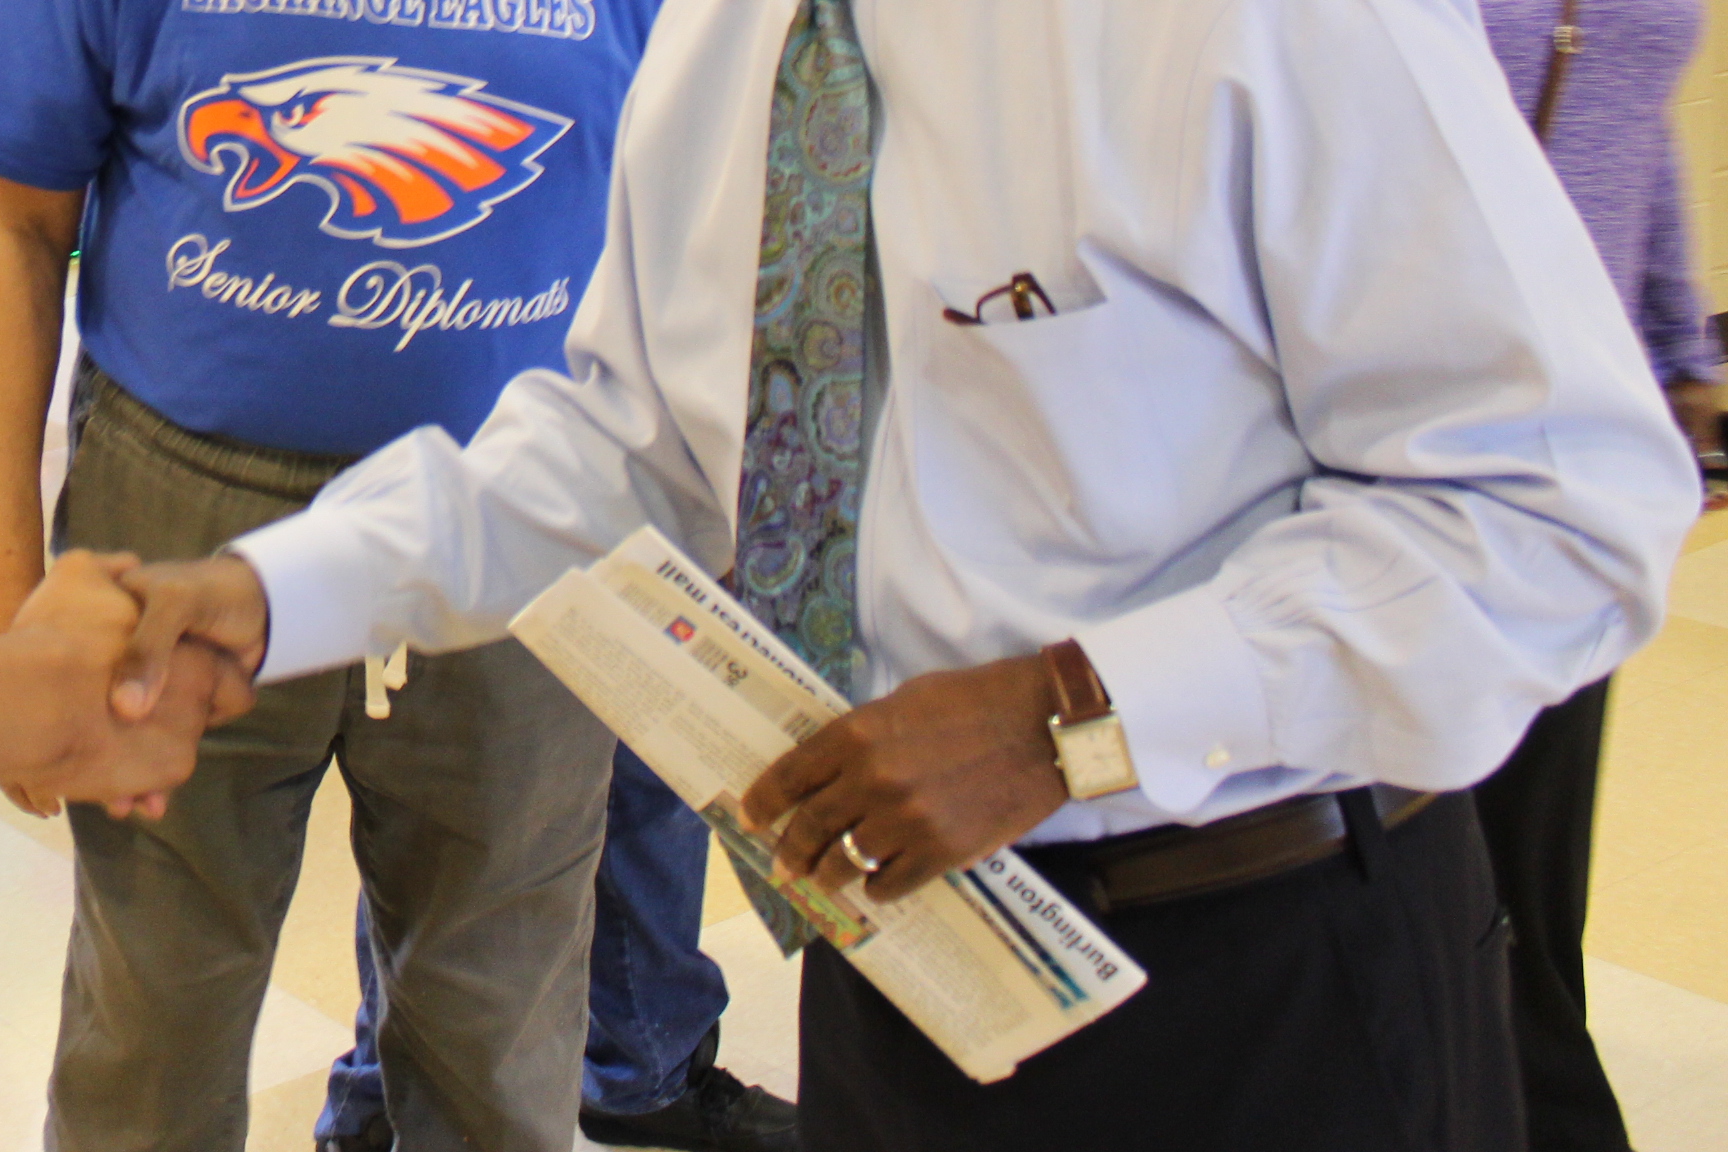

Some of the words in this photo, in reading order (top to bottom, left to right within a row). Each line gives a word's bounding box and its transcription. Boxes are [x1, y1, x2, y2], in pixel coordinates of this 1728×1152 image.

[165, 233, 321, 319] Senior
[328, 260, 570, 354] Diplomats
[655, 559, 707, 604] mall
[1006, 875, 1119, 981] Burlington
